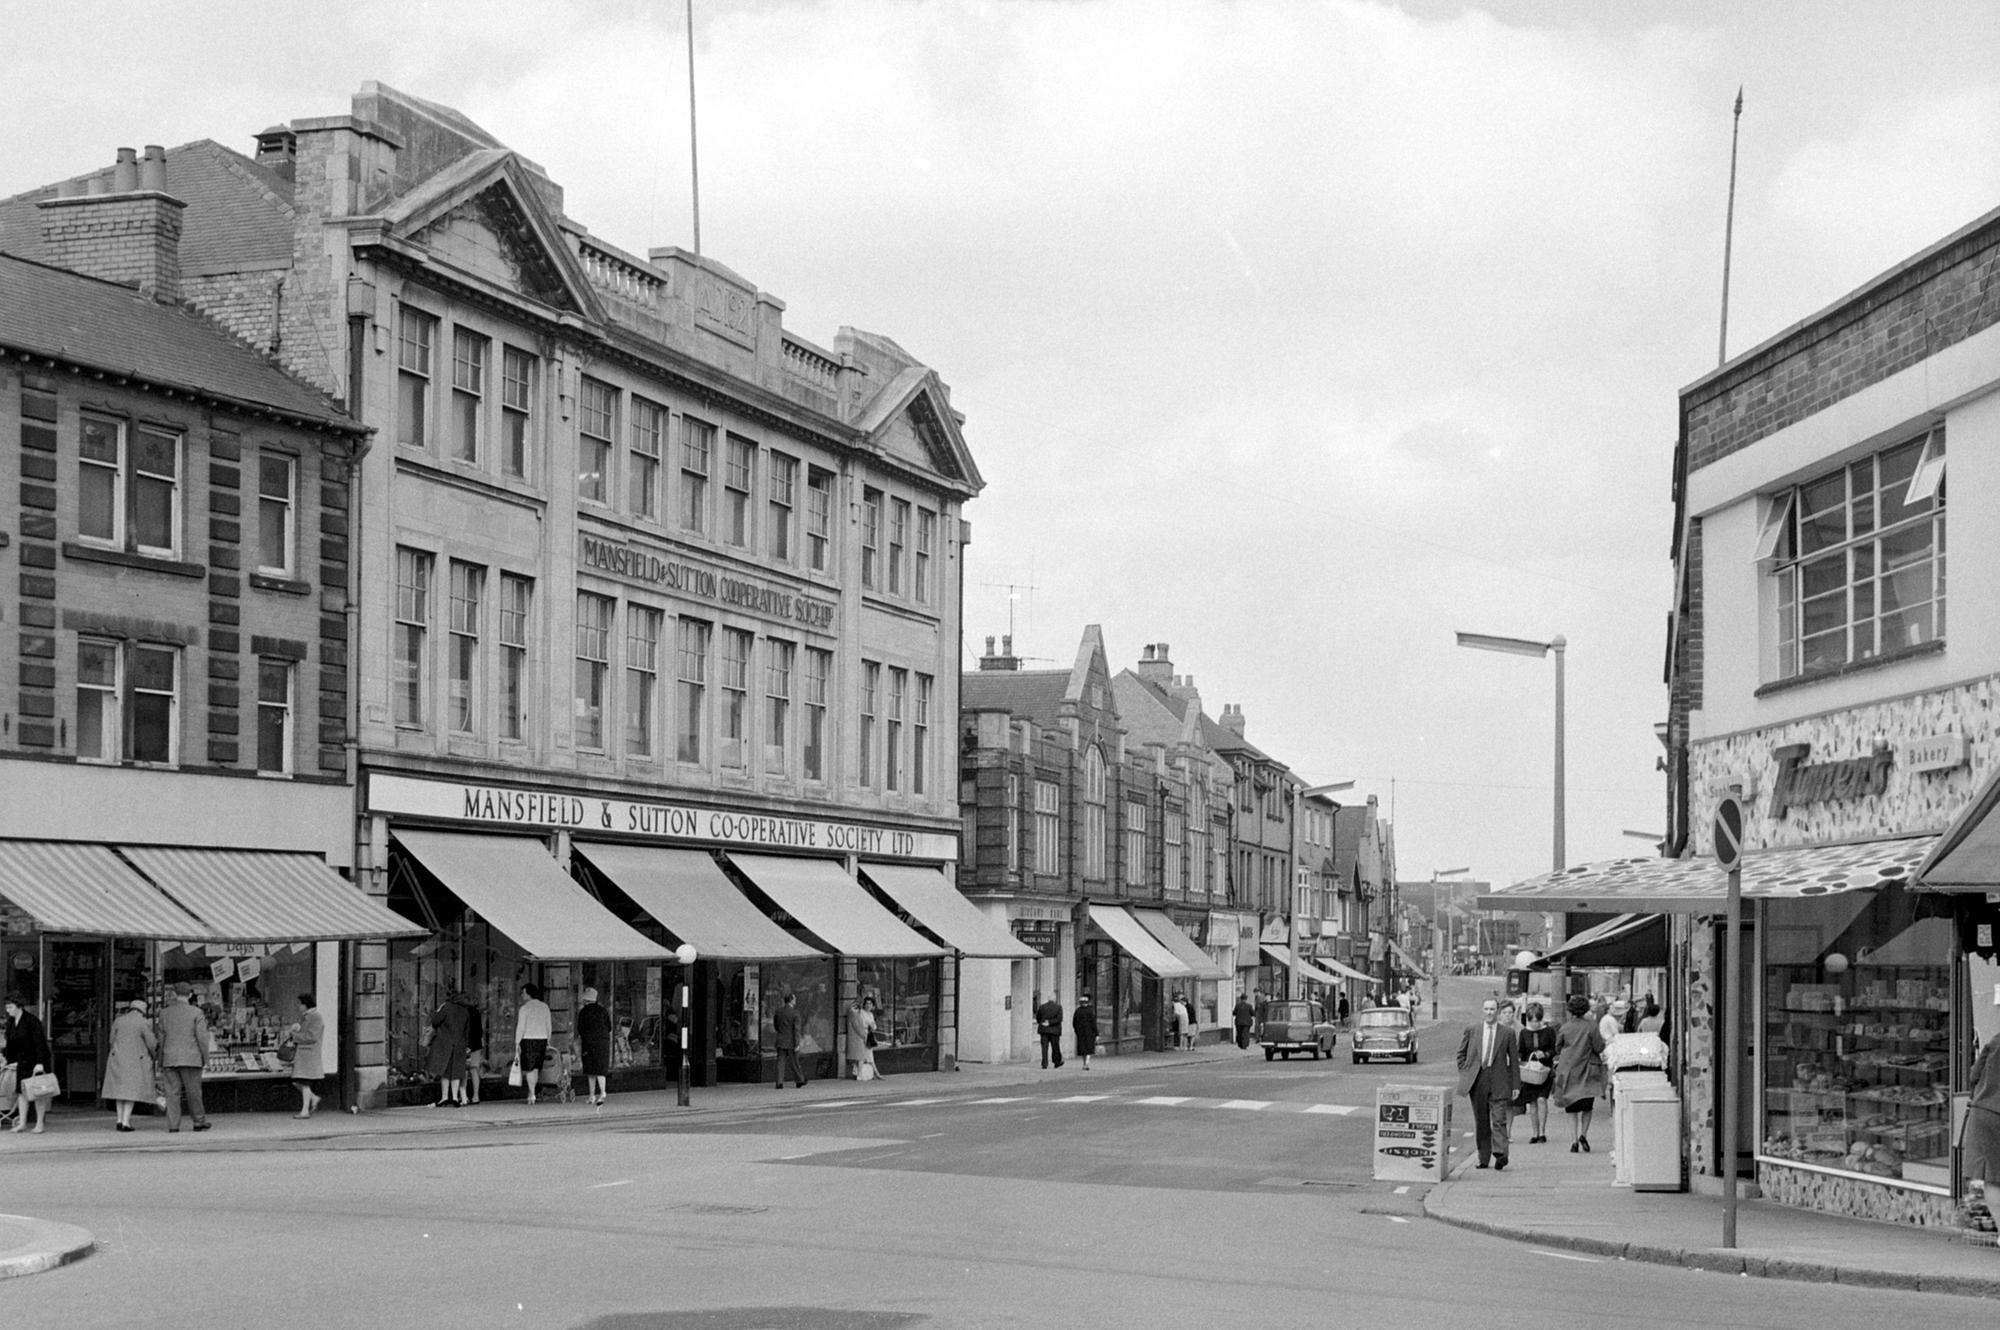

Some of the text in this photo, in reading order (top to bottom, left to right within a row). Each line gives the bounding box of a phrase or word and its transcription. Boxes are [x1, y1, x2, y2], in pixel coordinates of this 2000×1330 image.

[584, 537, 660, 583] MANSFIELD
[667, 561, 717, 599] SUTTON
[1909, 745, 1949, 765] Bakery
[464, 788, 915, 854] MANSFIELD & SUTTON CO-OPERATIVE SOCIETY LTD
[1022, 936, 1051, 944] MIDLAND
